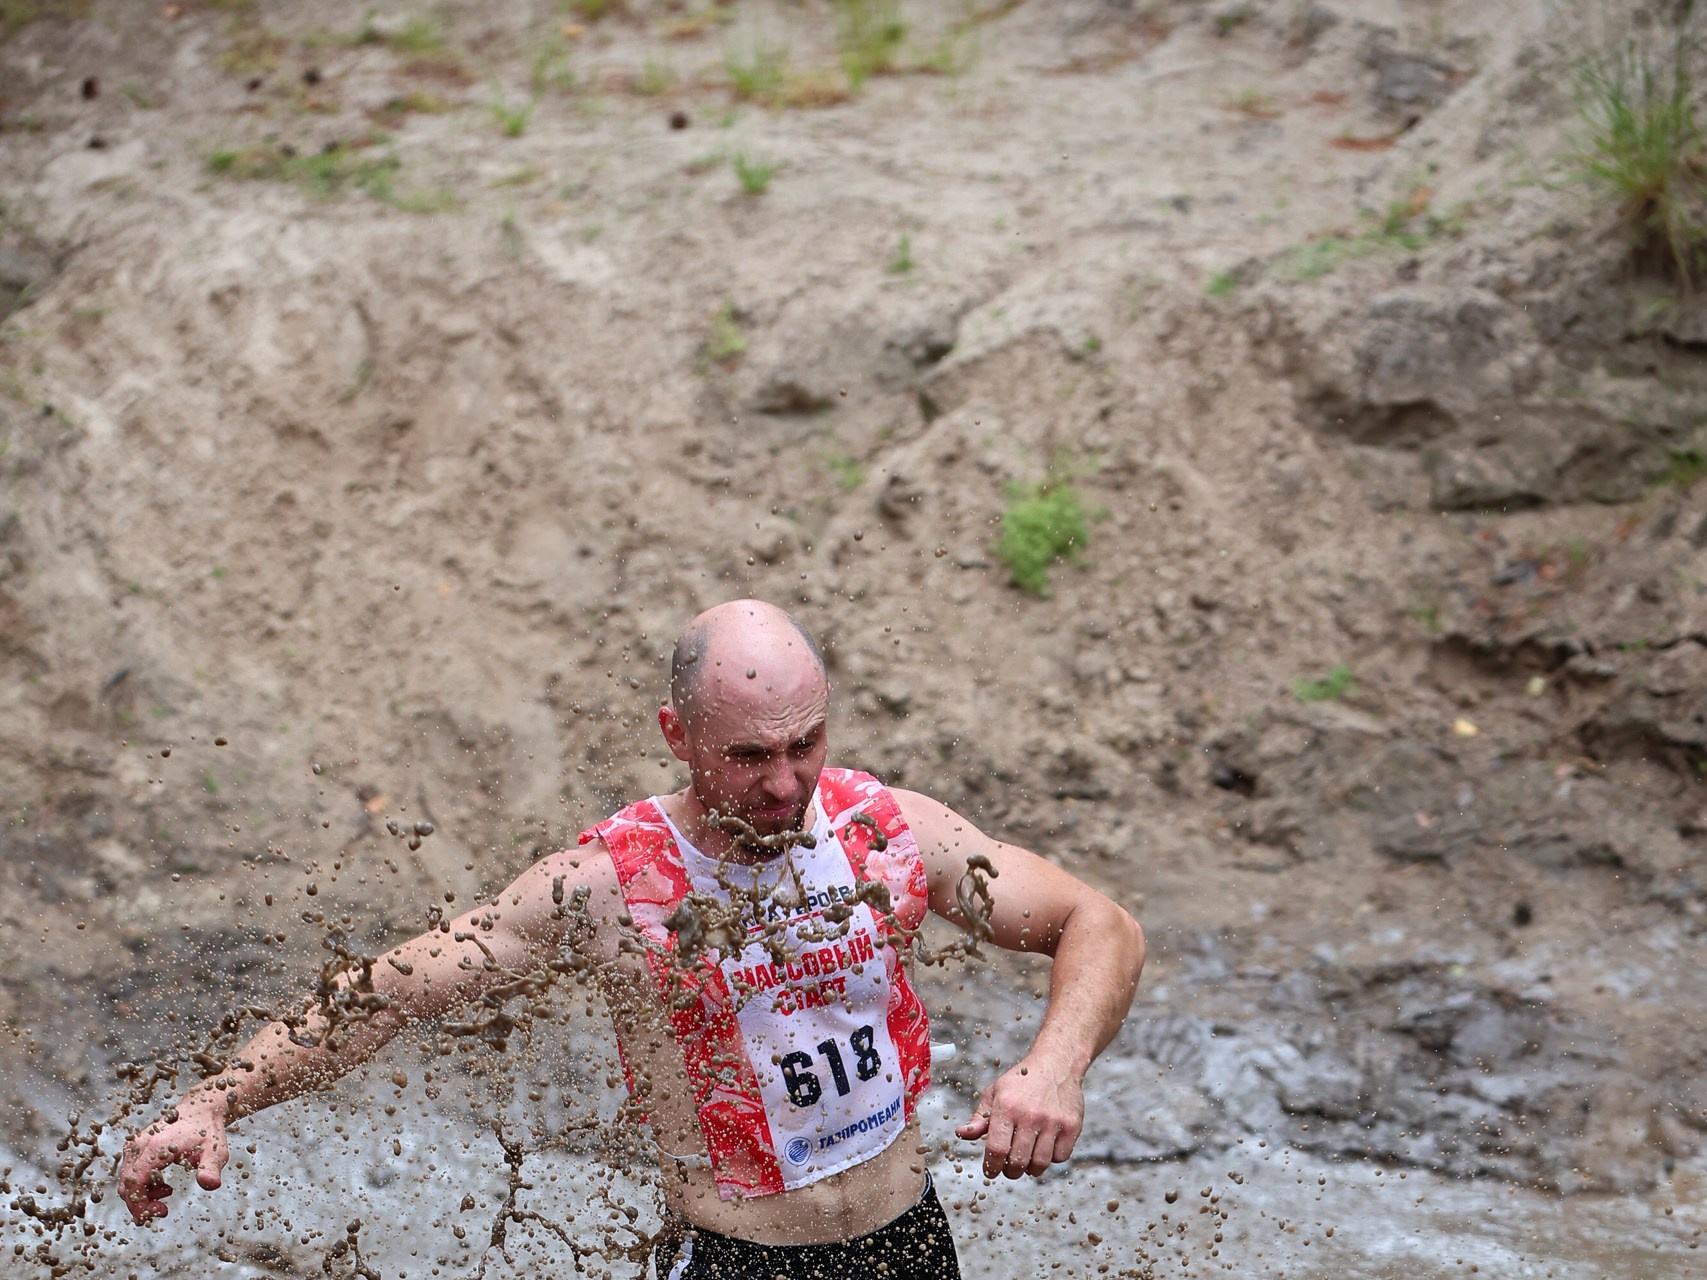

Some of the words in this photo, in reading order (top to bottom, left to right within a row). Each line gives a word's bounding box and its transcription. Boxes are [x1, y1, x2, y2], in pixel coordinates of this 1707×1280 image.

[734, 928, 875, 996] МАССОВЫЙ
[776, 976, 846, 1016] СТАРТ
[781, 1025, 882, 1108] 618
